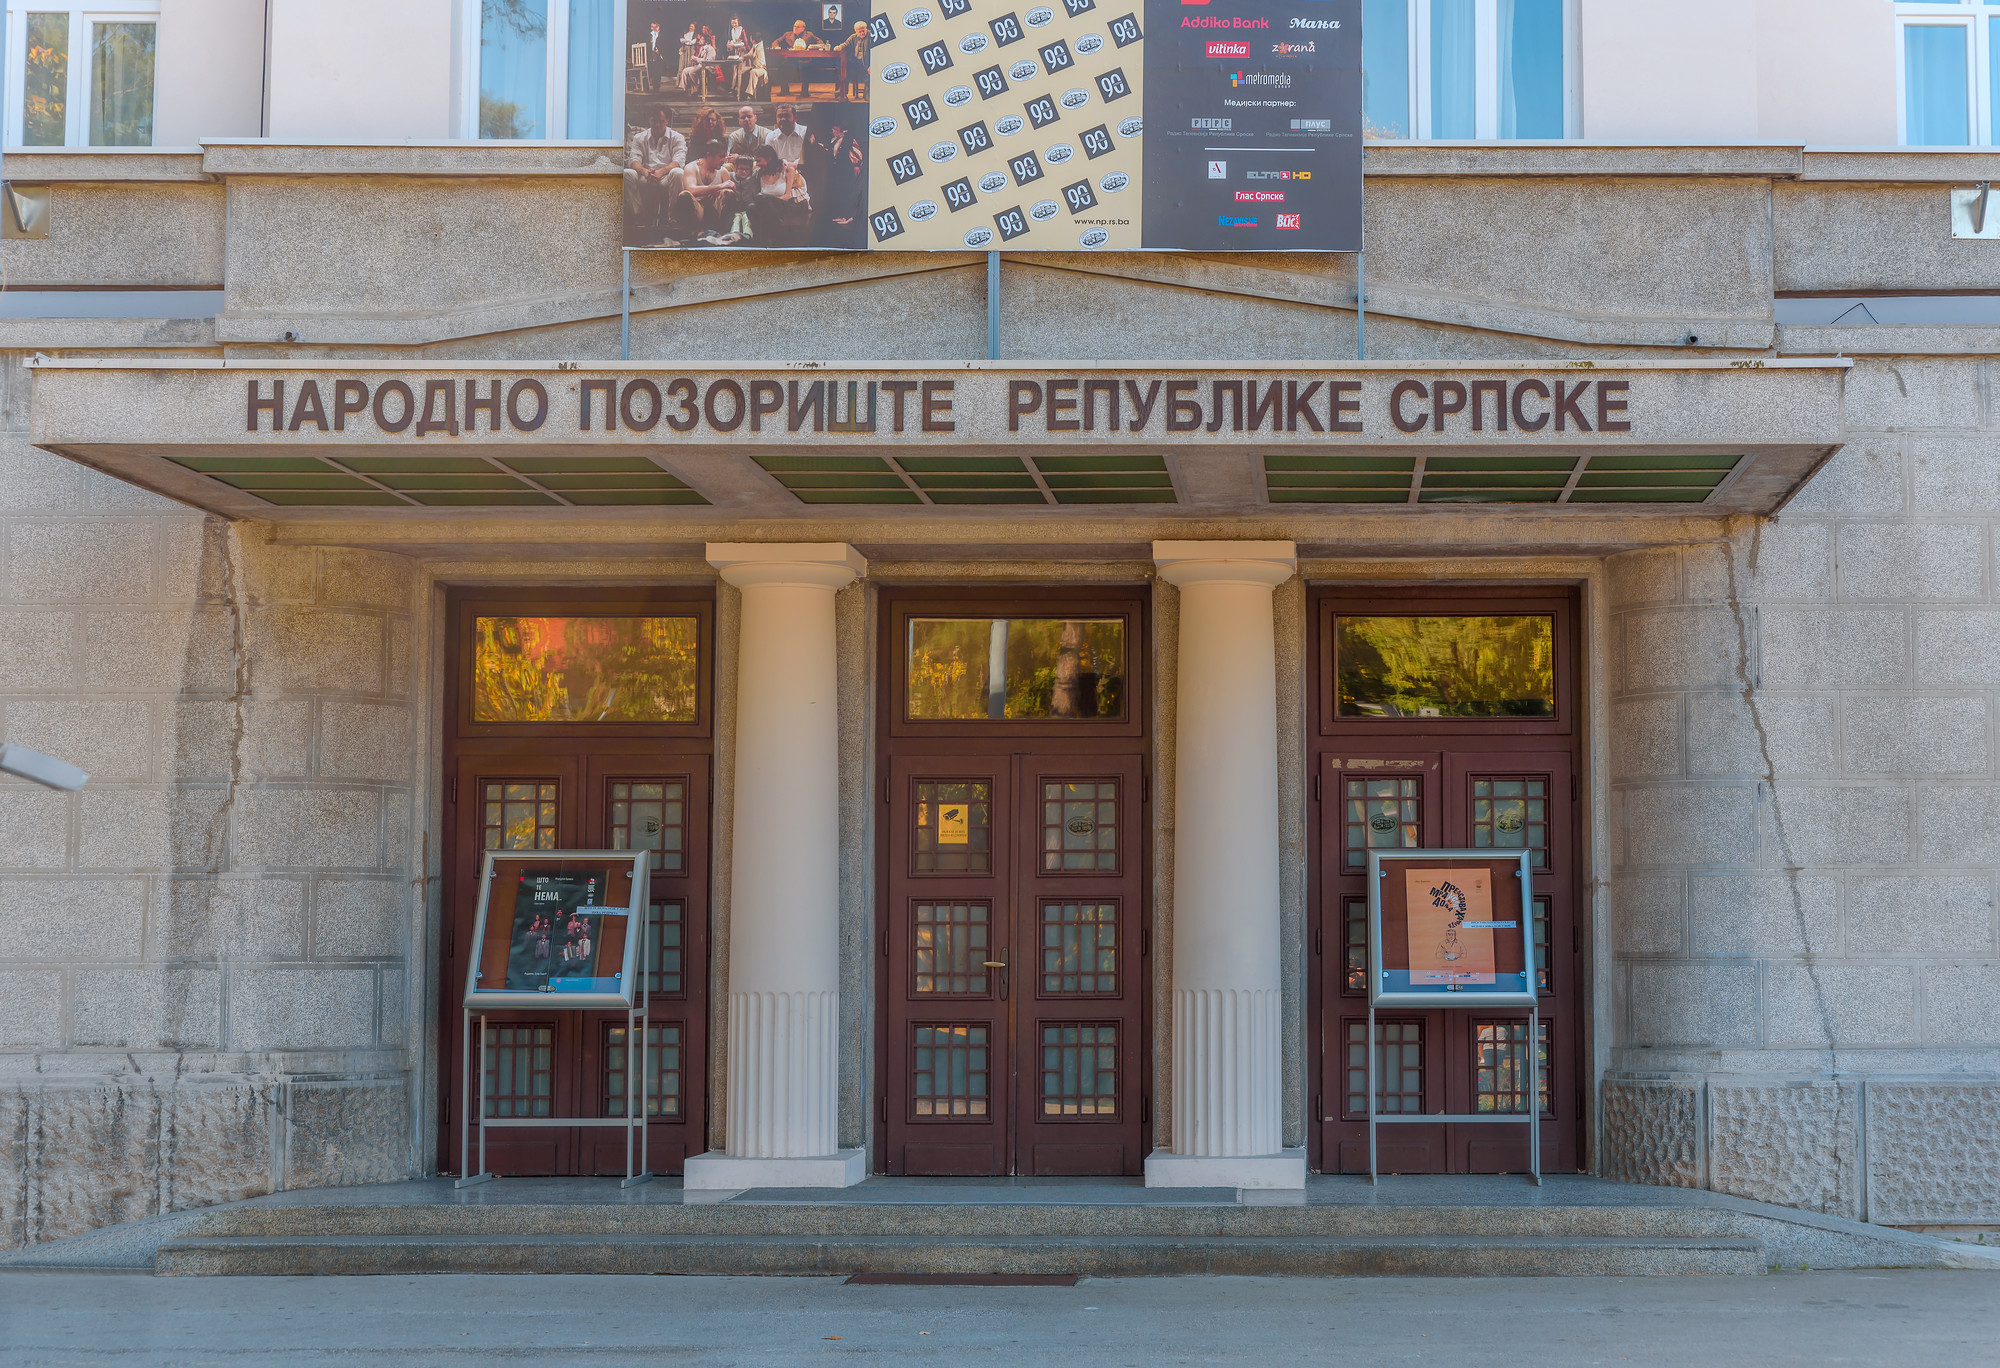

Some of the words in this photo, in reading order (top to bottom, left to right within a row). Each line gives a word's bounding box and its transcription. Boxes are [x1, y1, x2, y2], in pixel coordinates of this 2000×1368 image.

[994, 18, 1018, 42] 90
[1113, 18, 1137, 43] 90
[1181, 16, 1230, 28] Addiko
[1233, 16, 1269, 29] Bank
[1289, 18, 1341, 29] Мања
[923, 46, 947, 70] 90
[1044, 45, 1068, 70] 90
[1208, 43, 1247, 55] vitinka
[978, 70, 1002, 95] 90
[1101, 73, 1125, 98] 90
[1245, 71, 1291, 85] metromedia
[908, 100, 932, 125] 90
[1030, 99, 1054, 124] 90
[1224, 99, 1261, 107] Медијски
[1263, 100, 1297, 108] партнер:
[963, 126, 987, 151] 90
[1084, 130, 1109, 155] 90
[892, 155, 916, 180] 90
[1013, 156, 1038, 181] 90
[1292, 171, 1312, 180] HD
[947, 182, 971, 207] 90
[1067, 184, 1091, 209] 90
[1235, 191, 1254, 200] Глас
[1255, 191, 1284, 201] Српске
[874, 212, 898, 237] 90
[999, 211, 1023, 236] 90
[1073, 218, 1130, 226] www.np.rs.ba
[247, 379, 548, 437] НАРОДНО
[580, 379, 956, 432] ПОЗОРИШТЕ
[1008, 379, 1363, 433] РЕПУБЛИКЕ
[1390, 378, 1632, 433] СРПСКЕ
